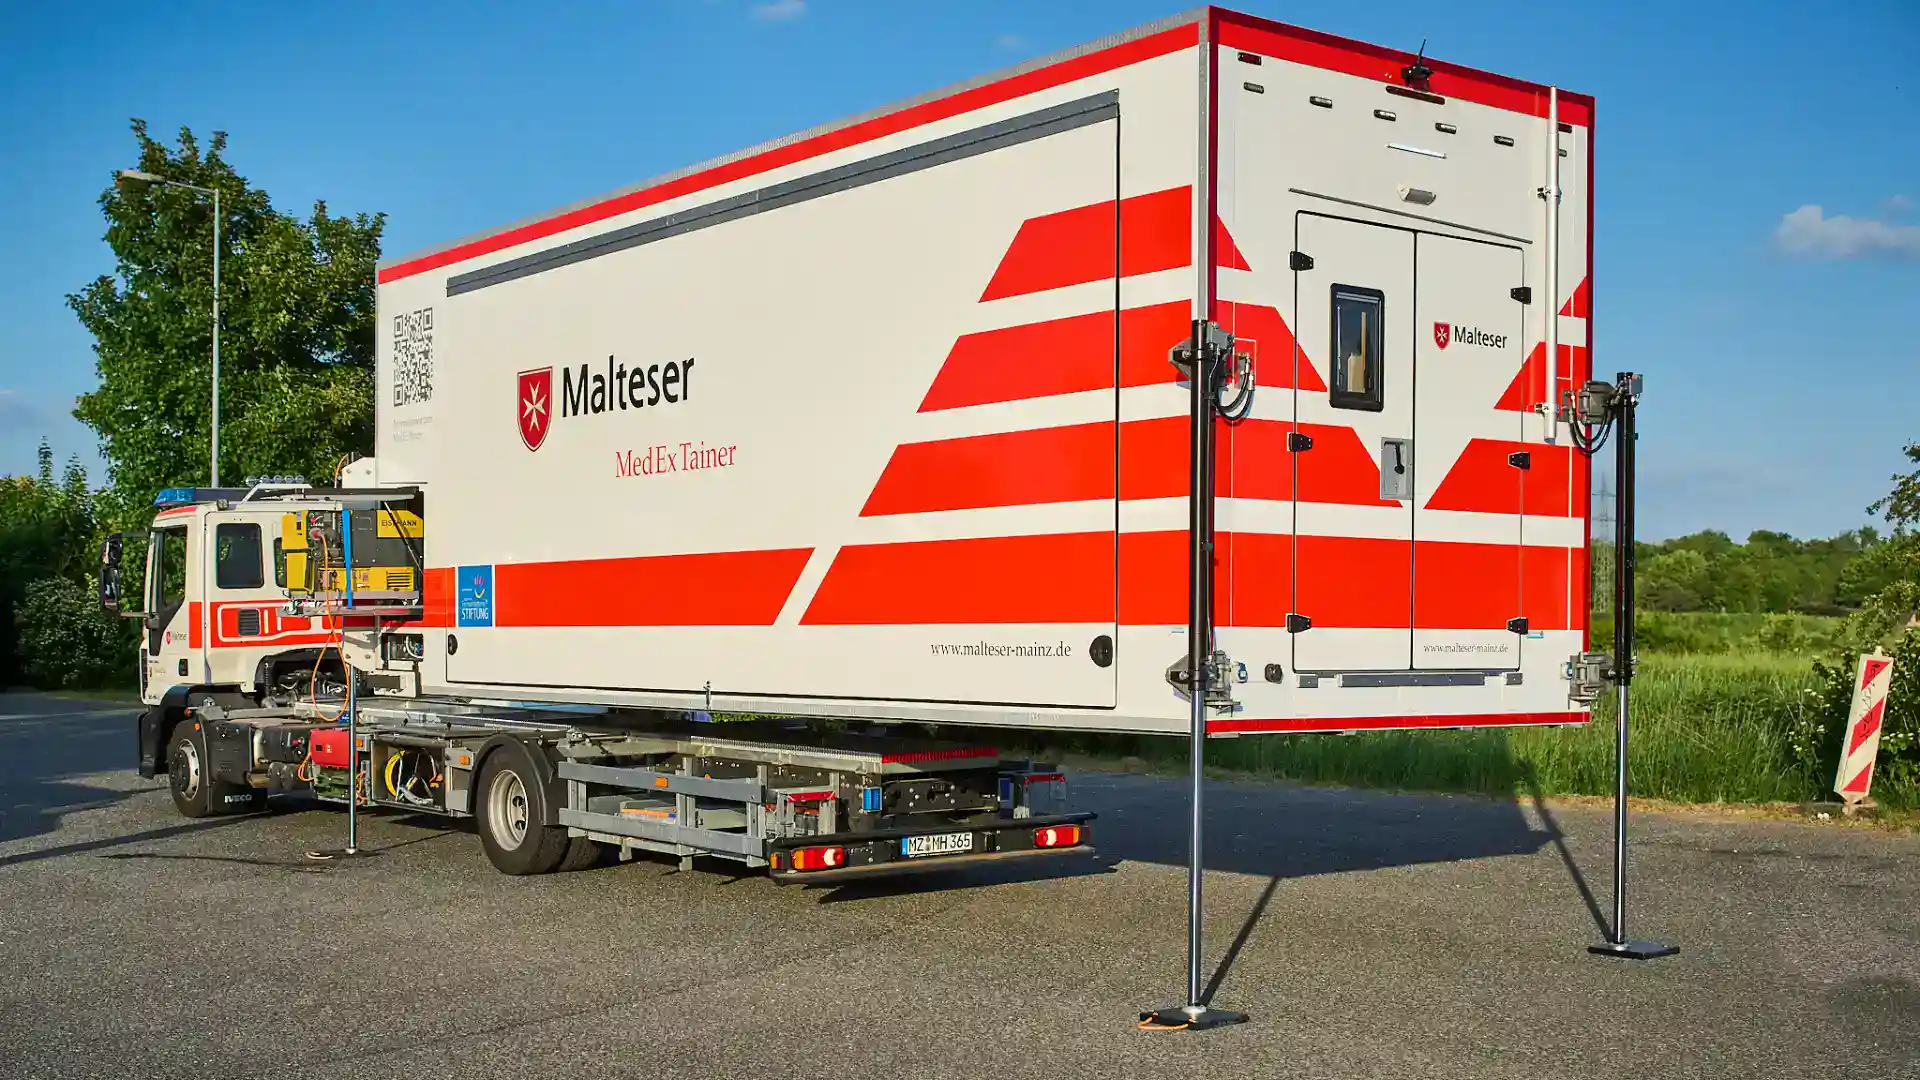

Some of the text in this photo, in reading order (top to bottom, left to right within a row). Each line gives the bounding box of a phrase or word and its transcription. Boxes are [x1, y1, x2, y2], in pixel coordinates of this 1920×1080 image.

[1454, 325, 1507, 348] Malteser
[562, 354, 695, 418] Malteser
[381, 519, 417, 527] EISMANN
[461, 607, 489, 620] STIFTUNG
[930, 640, 1072, 657] www.malteser-mainz.de
[1423, 642, 1509, 653] www.malteser-mainz.de
[224, 794, 252, 804] IVECO
[909, 834, 970, 852] MZ MH 365
